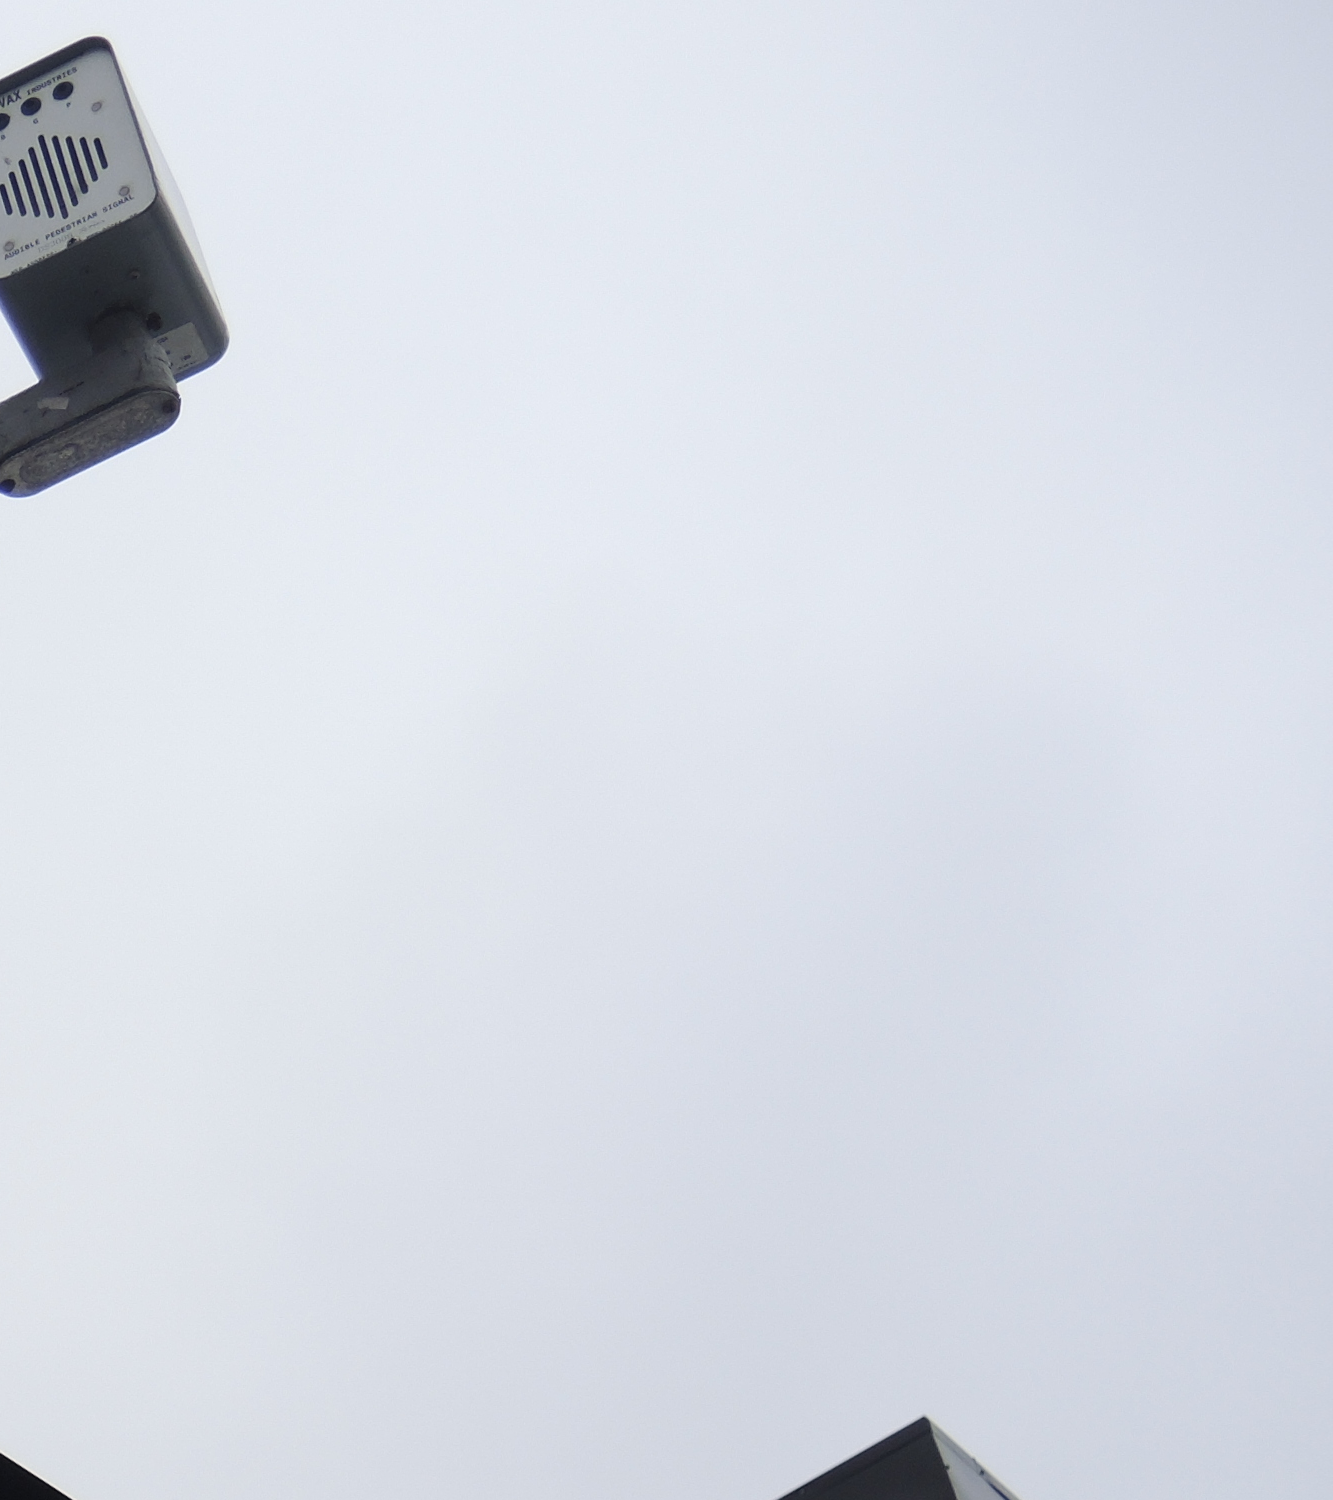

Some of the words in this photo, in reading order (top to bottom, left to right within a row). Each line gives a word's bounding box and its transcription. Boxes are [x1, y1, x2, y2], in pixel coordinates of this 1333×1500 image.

[26, 66, 78, 96] INDUSTRIES
[4, 238, 41, 260] AUDIBLE
[45, 211, 98, 240] PEDESTRIAN
[102, 194, 135, 213] SIGNAL
